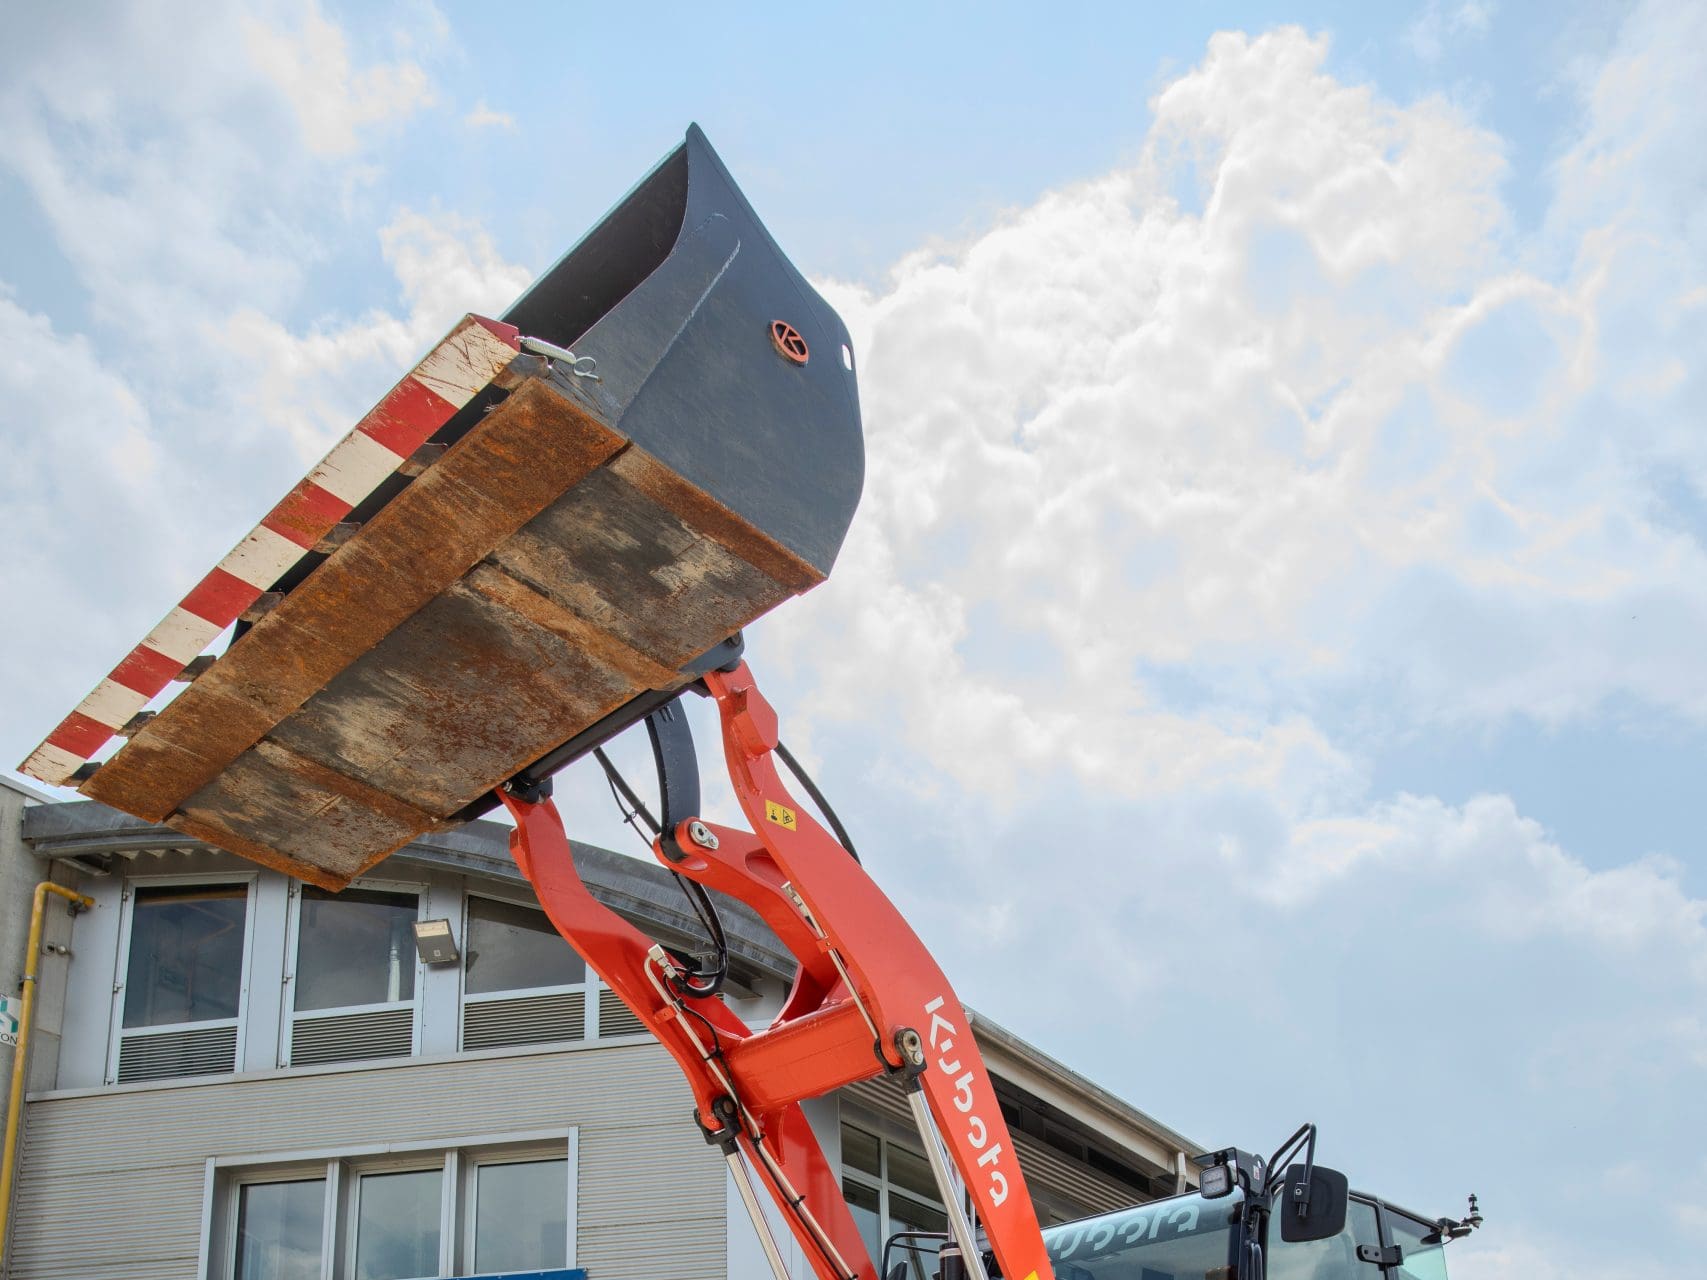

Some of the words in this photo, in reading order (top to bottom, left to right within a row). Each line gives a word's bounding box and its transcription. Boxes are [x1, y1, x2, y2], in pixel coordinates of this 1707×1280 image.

[0, 1032, 17, 1045] ON
[924, 995, 1009, 1208] Kubota
[1052, 1204, 1200, 1260] ubota
